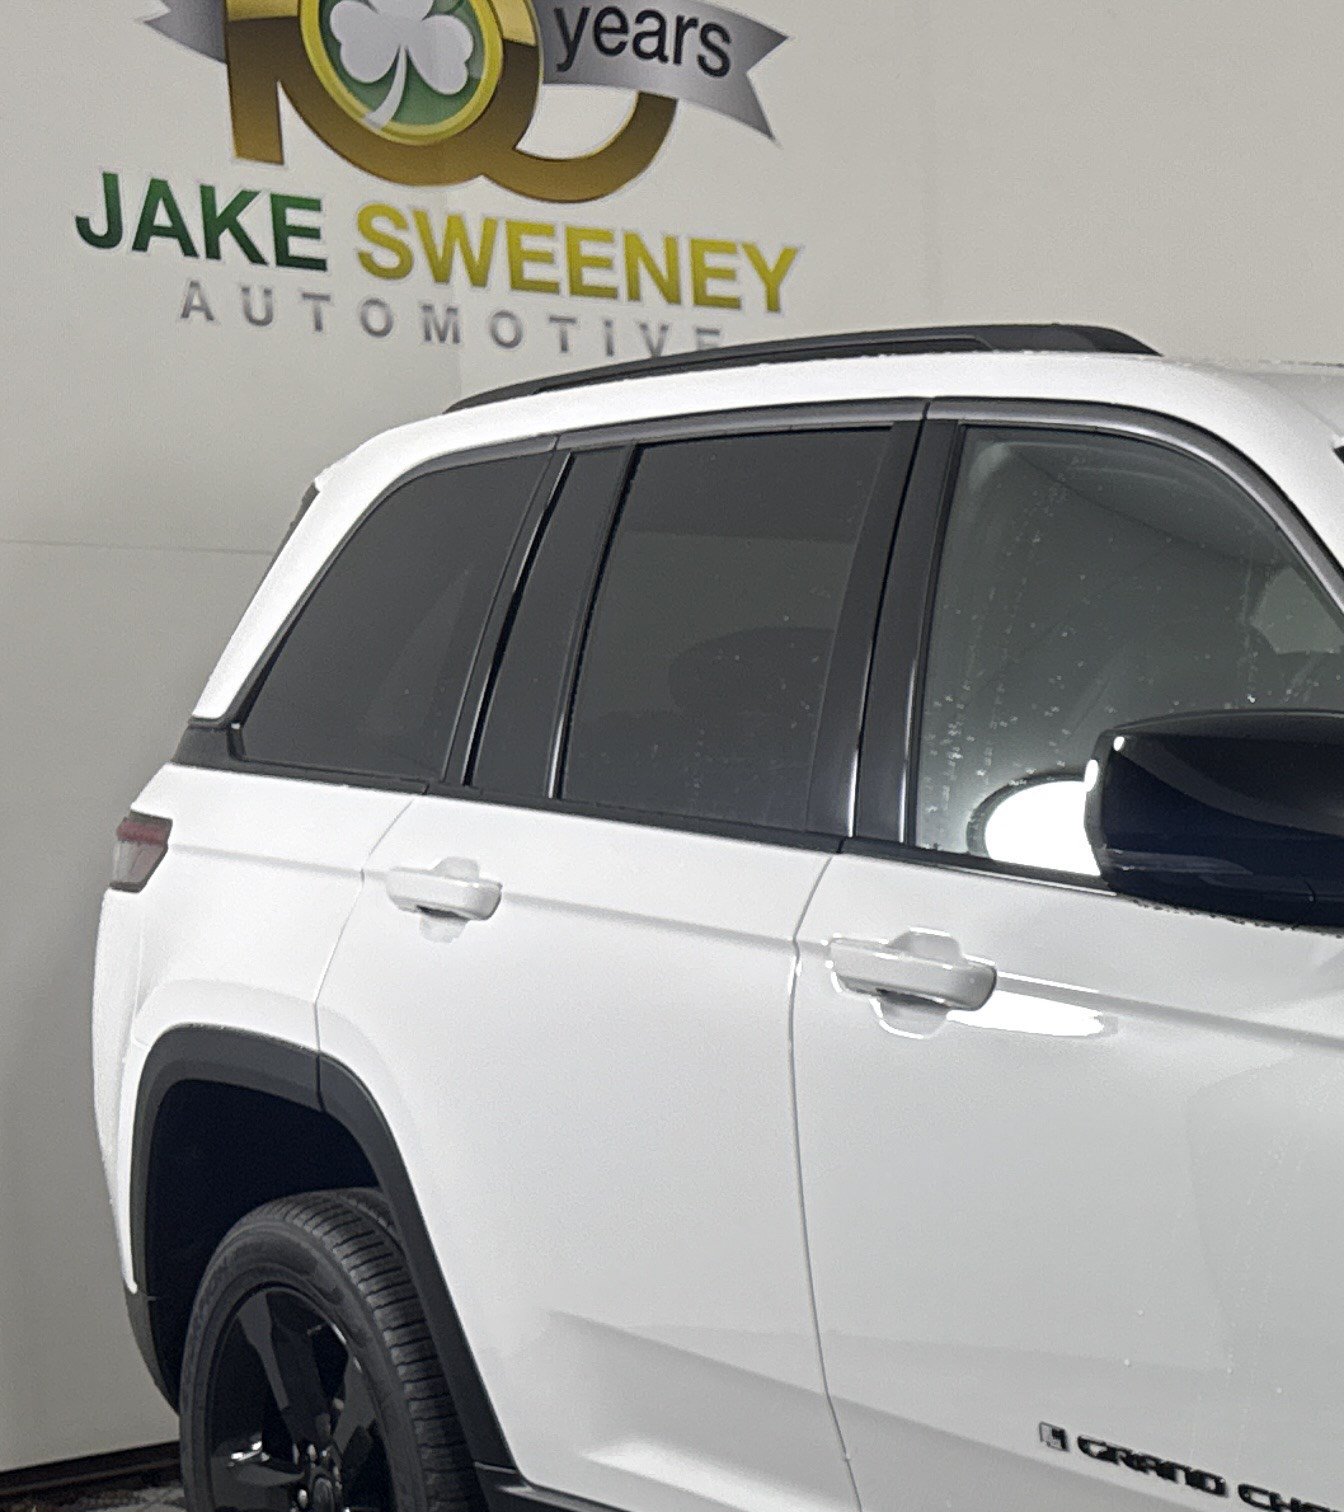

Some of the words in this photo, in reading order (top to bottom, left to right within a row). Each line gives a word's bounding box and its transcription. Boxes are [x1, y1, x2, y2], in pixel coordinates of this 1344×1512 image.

[554, 4, 733, 78] years
[75, 172, 328, 272] JAKE
[356, 204, 801, 314] SWEENEY
[180, 280, 724, 359] AUTOMOTIVE
[1076, 1434, 1230, 1498] GRAND
